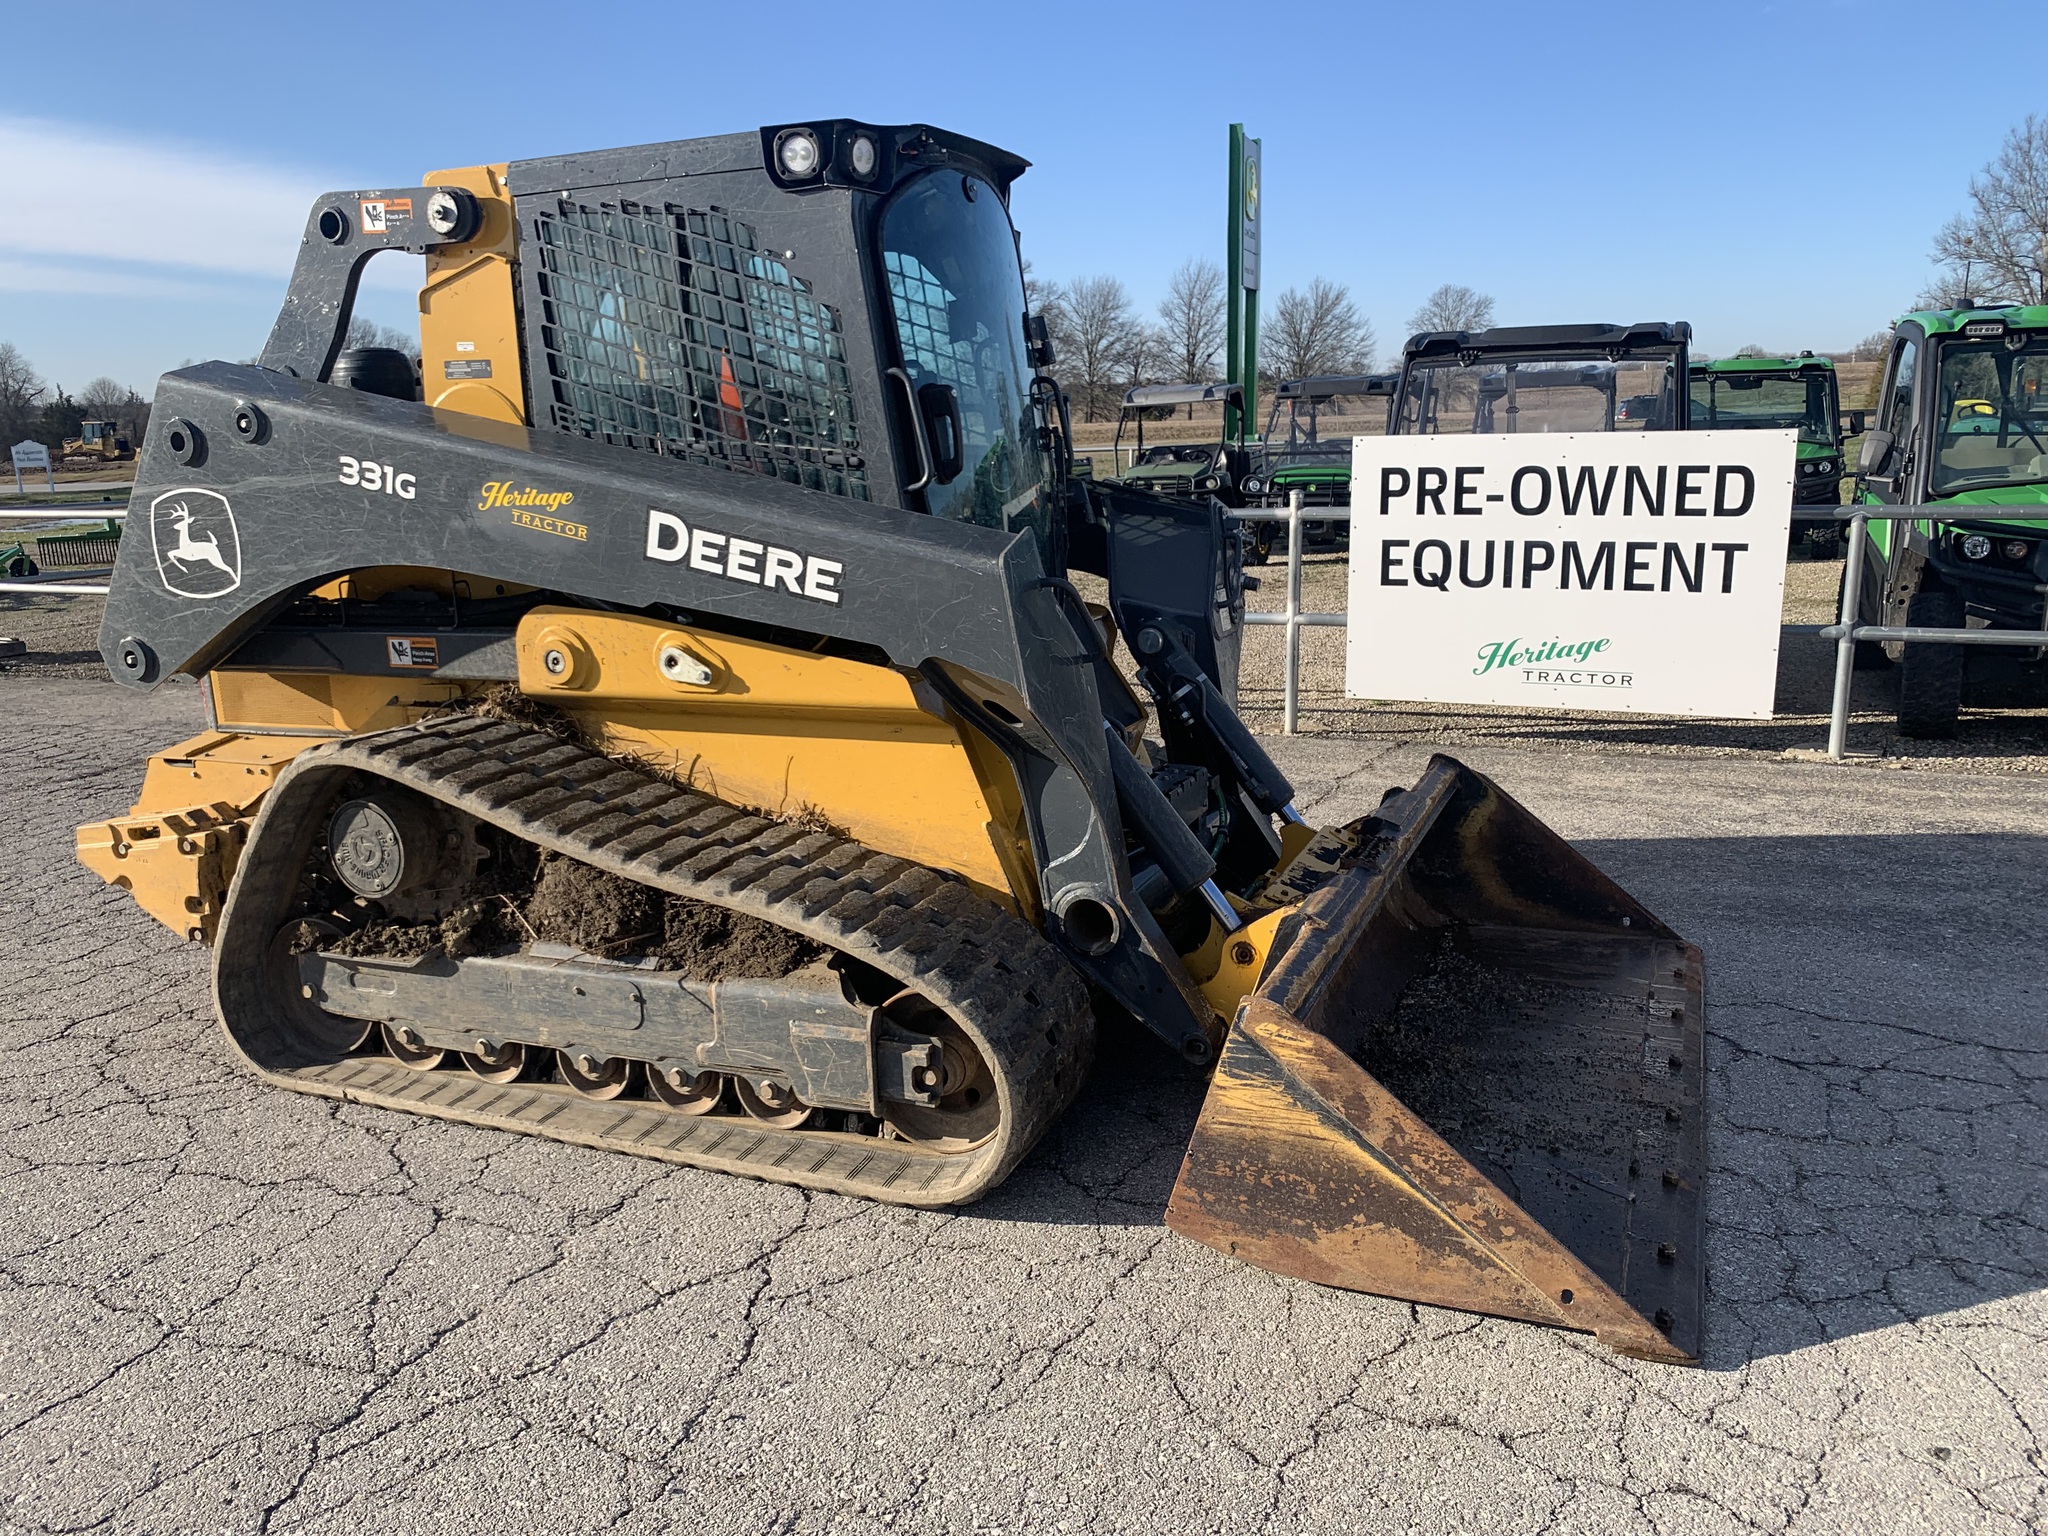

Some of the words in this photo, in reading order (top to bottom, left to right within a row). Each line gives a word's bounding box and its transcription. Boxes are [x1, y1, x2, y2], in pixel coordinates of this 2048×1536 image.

[338, 455, 417, 501] 331G
[478, 480, 575, 513] Heritage
[1379, 464, 1756, 518] PRE-OWNED
[511, 509, 588, 541] TRACTOR
[645, 509, 844, 603] DEERE
[1380, 539, 1749, 594] EQUIPMENT
[1472, 637, 1612, 677] Heritage
[1522, 669, 1634, 687] TRACTOR
